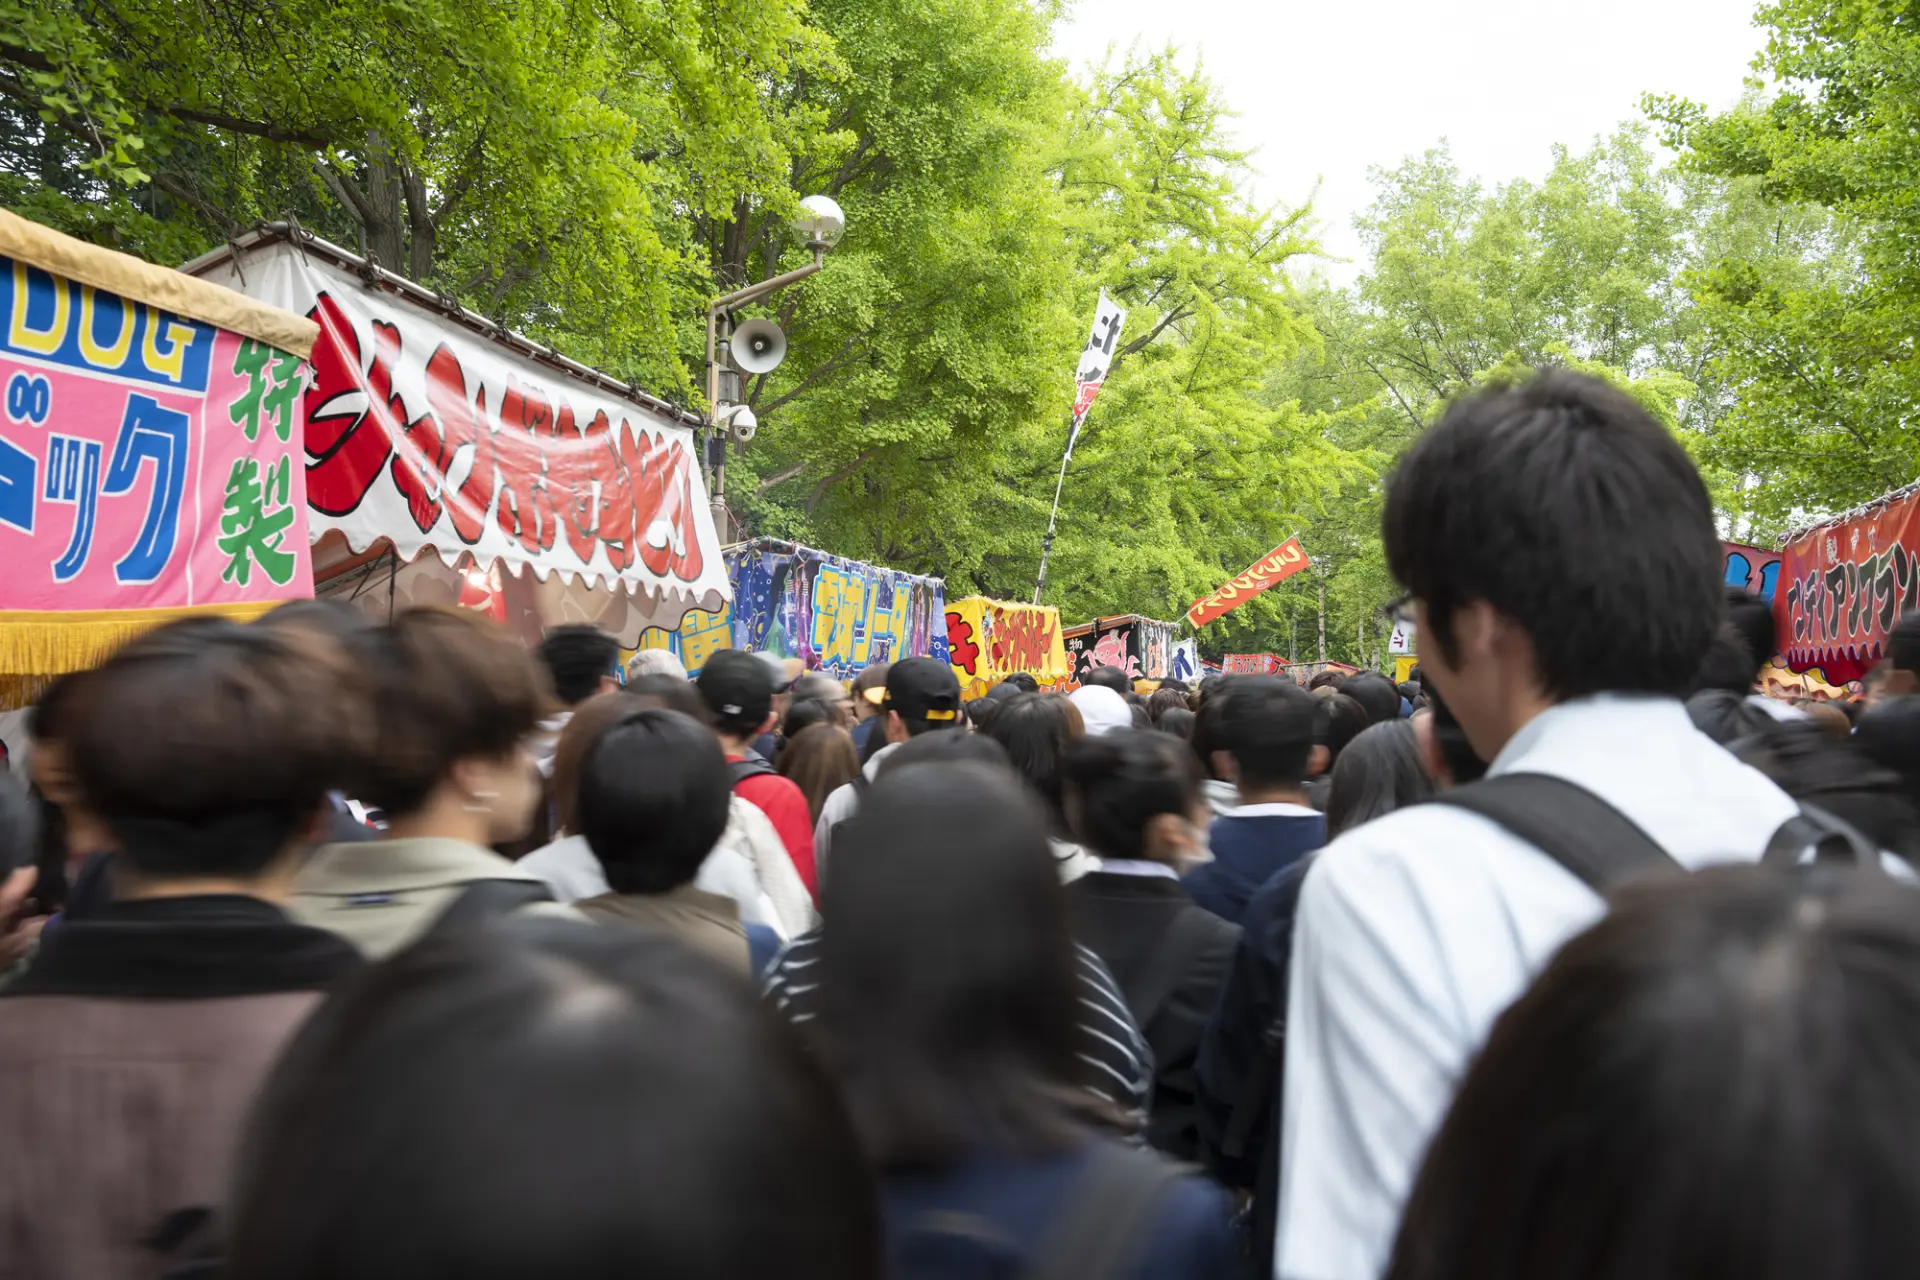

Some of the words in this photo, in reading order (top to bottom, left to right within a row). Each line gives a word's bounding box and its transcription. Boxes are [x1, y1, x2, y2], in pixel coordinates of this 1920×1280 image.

[9, 260, 196, 383] DOG
[217, 337, 304, 587] 特製
[1787, 540, 1920, 644] インディアンフラン
